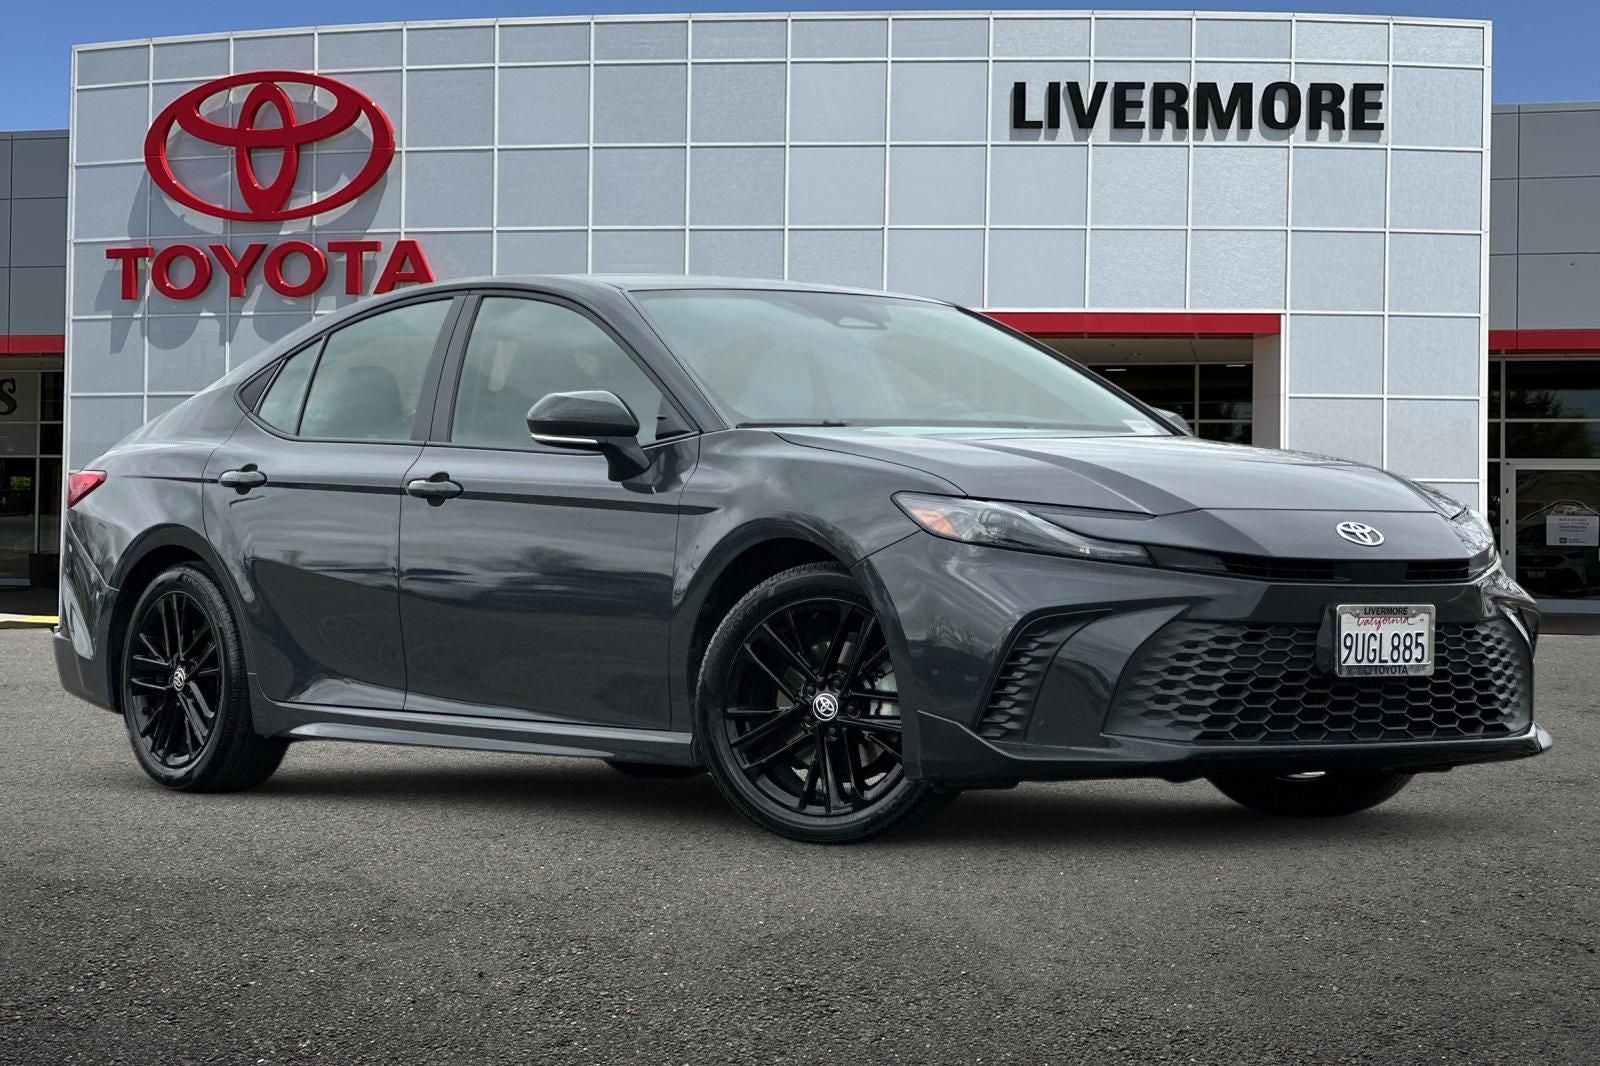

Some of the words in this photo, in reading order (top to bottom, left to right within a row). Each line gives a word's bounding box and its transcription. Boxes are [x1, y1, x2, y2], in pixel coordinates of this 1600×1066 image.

[1013, 81, 1384, 131] LIVERMORE
[106, 239, 435, 300] TOYOTA
[1364, 607, 1408, 615] LIVERMORE
[1357, 617, 1415, 630] California
[1342, 632, 1424, 664] 9UGL885
[1373, 665, 1408, 675] TOYOTA
